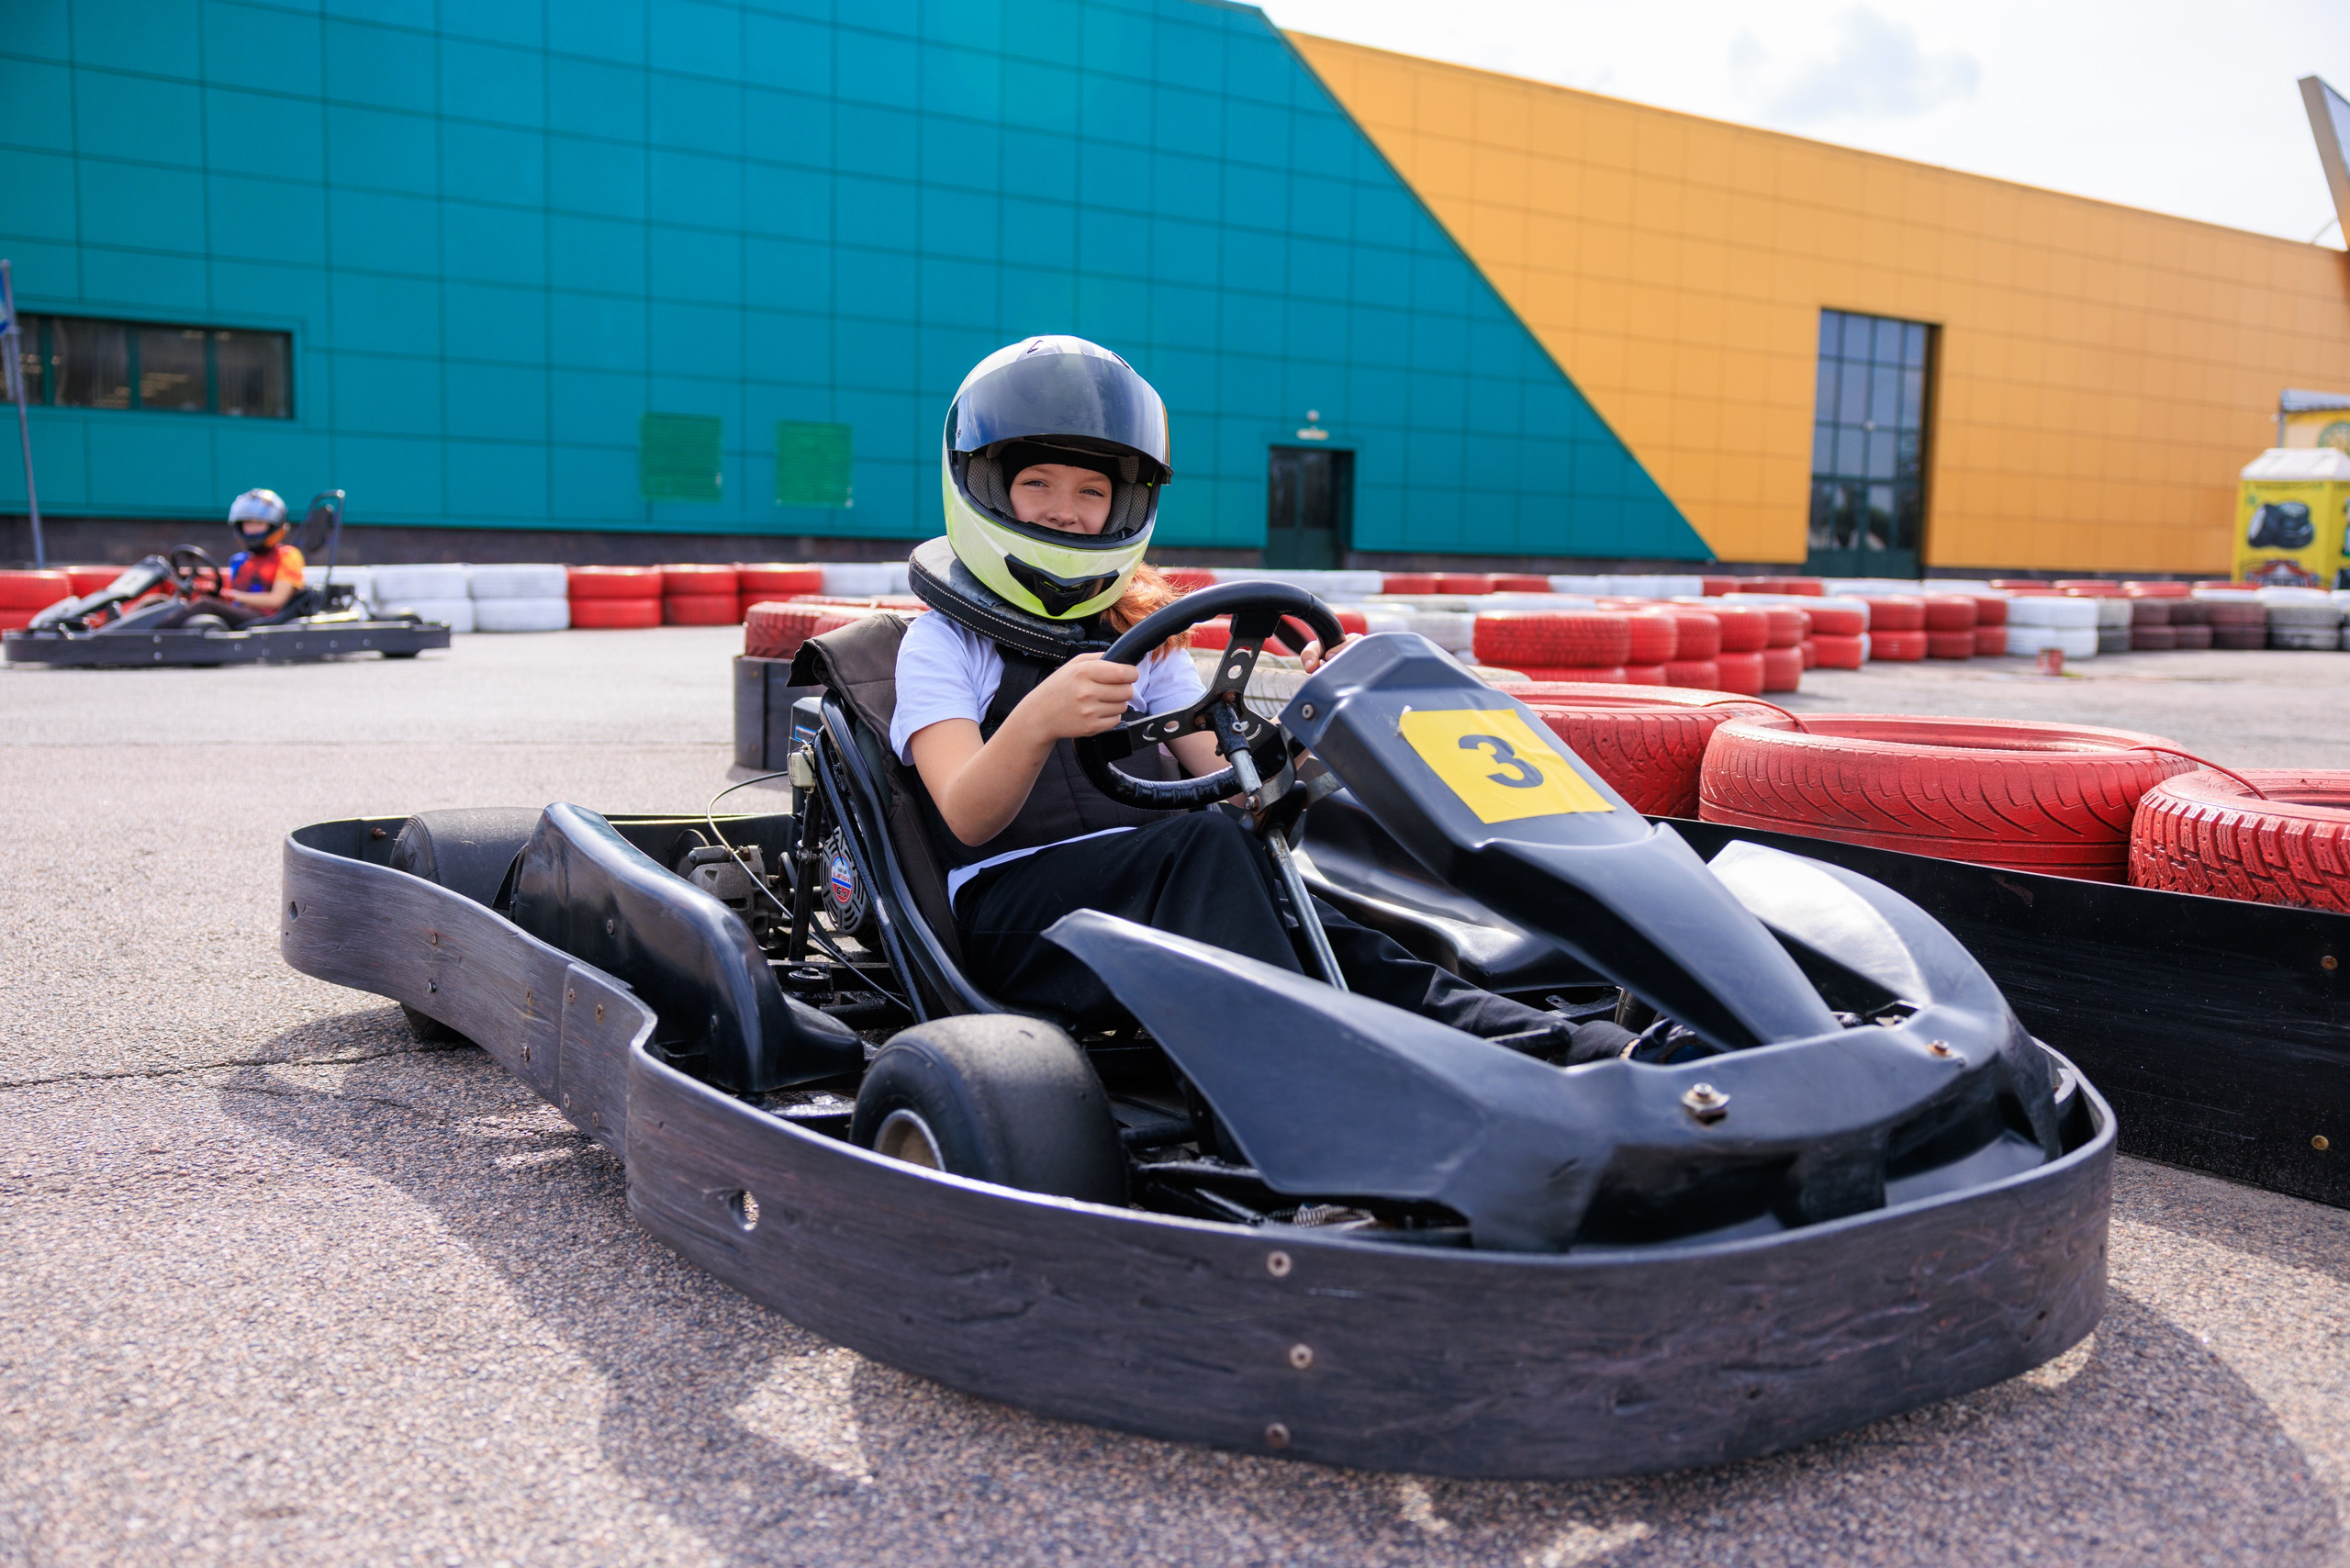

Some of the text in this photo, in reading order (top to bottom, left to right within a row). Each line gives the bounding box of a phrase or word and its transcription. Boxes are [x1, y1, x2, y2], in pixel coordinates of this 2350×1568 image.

[1458, 734, 1544, 788] 3
[833, 872, 850, 883] LIFAN
[836, 886, 847, 898] 6.5
